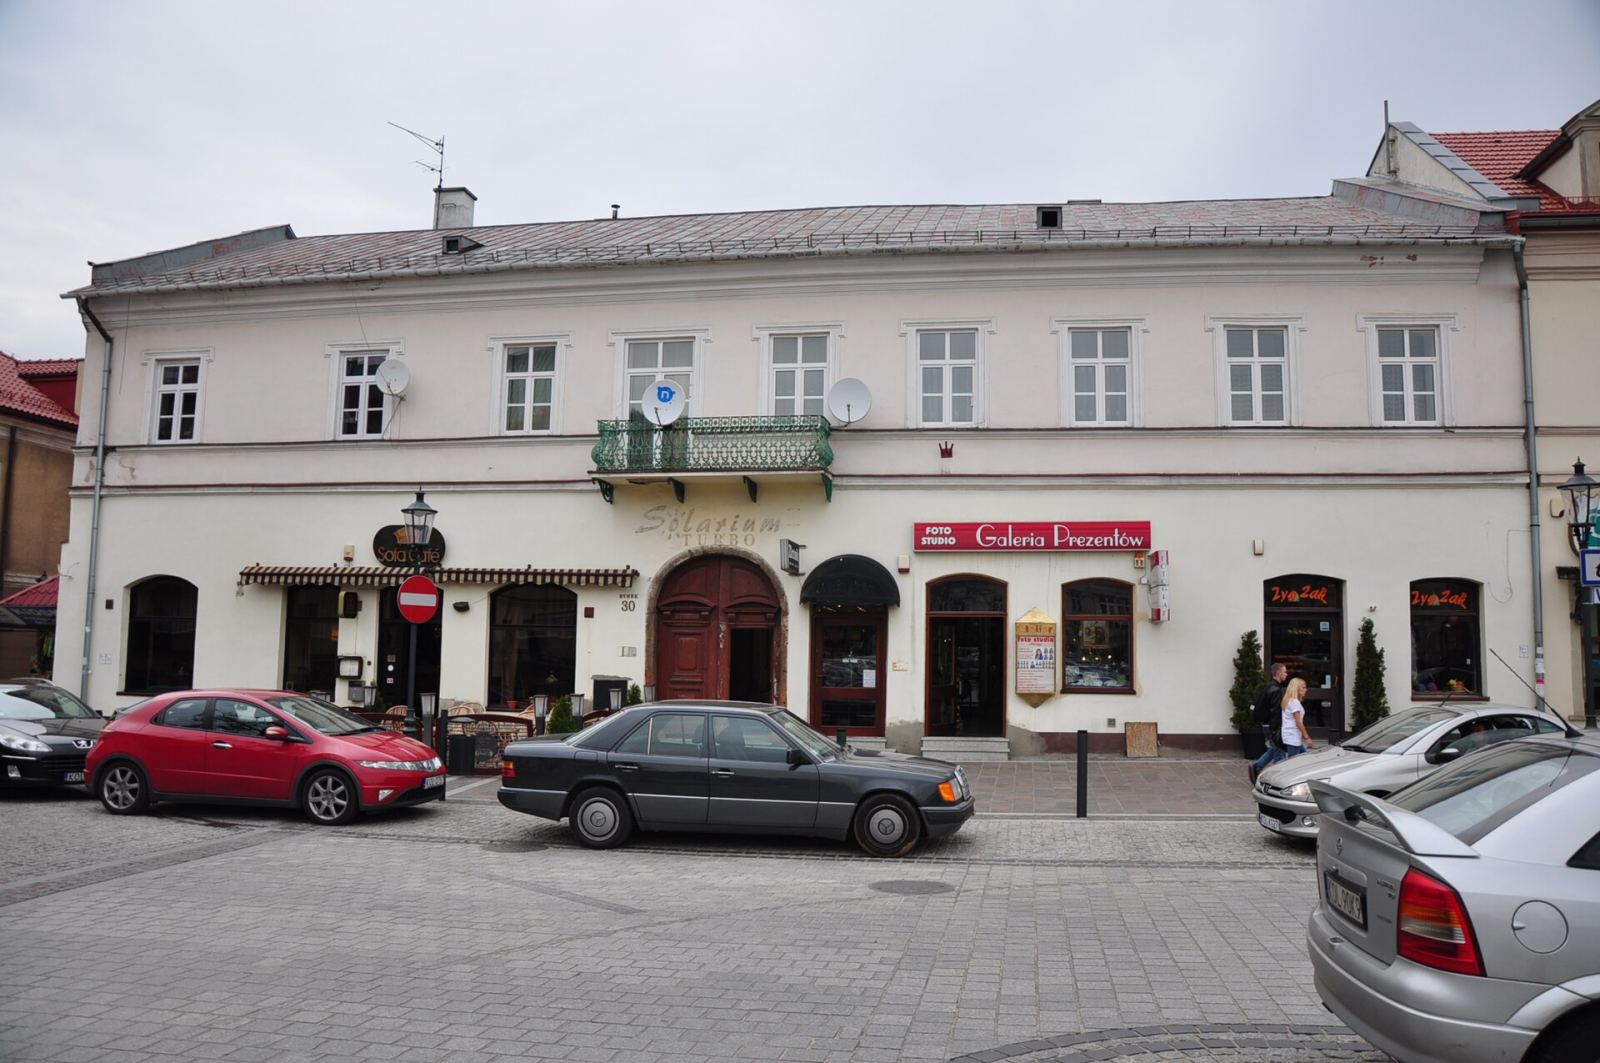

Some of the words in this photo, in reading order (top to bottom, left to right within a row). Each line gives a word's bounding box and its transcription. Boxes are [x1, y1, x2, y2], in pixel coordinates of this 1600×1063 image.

[925, 526, 952, 535] FOTO
[976, 524, 1045, 547] Galeria
[1053, 524, 1144, 547] Prezentów
[683, 534, 756, 547] TURBO
[921, 537, 957, 545] STUDIO
[378, 546, 407, 562] Sofa
[621, 600, 635, 611] 30
